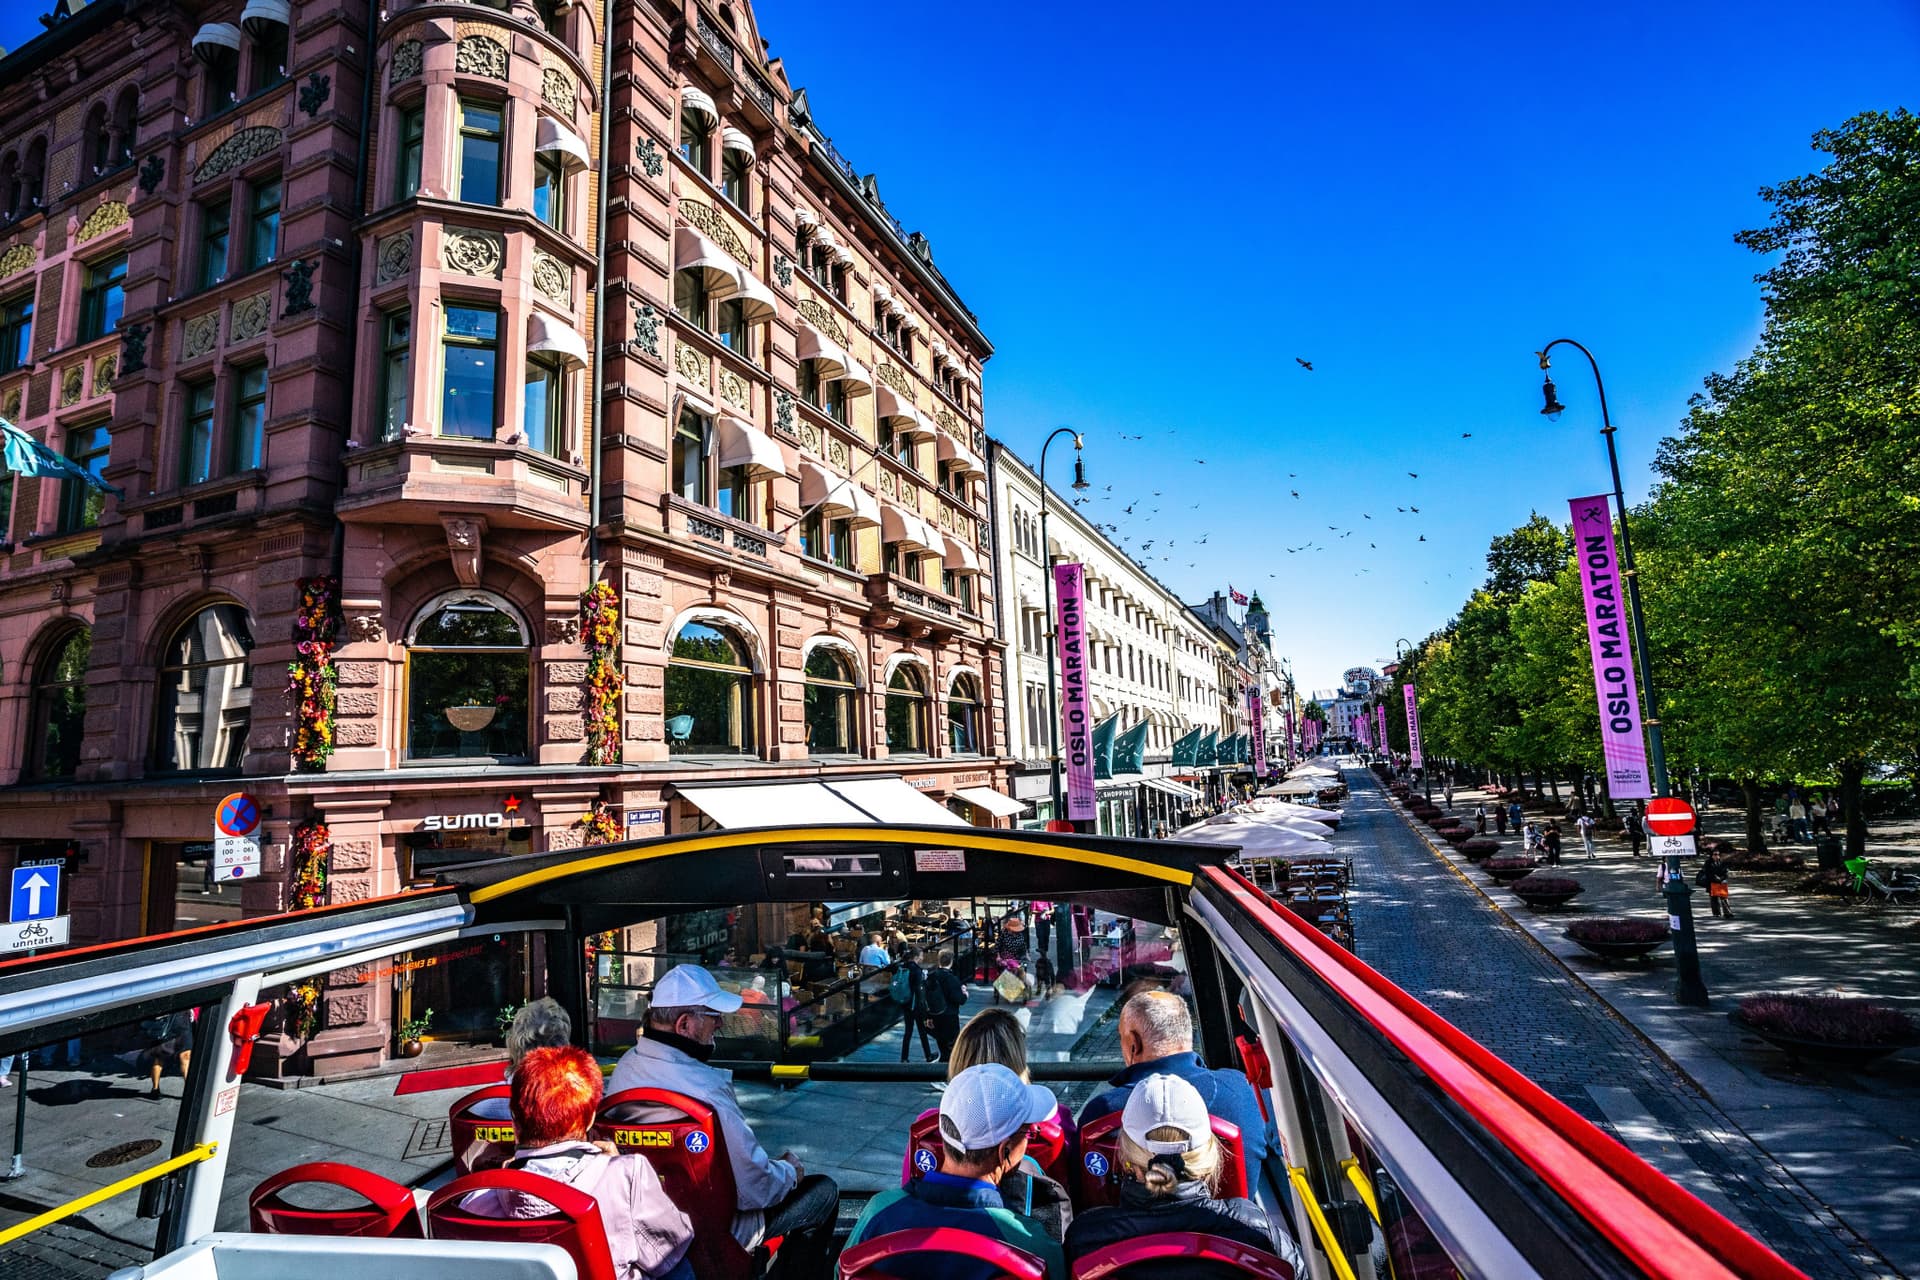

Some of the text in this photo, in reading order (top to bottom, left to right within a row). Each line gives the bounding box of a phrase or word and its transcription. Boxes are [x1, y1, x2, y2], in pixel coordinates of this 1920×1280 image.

[1584, 536, 1622, 658] MARATON
[1063, 598, 1086, 767] OSLO MARATON
[1408, 696, 1416, 731] MARATON
[1604, 667, 1632, 734] OSLO
[1103, 789, 1133, 798] SHOPPING
[424, 812, 503, 831] SUMO
[12, 936, 54, 949] unntatt
[686, 929, 728, 951] SUMO
